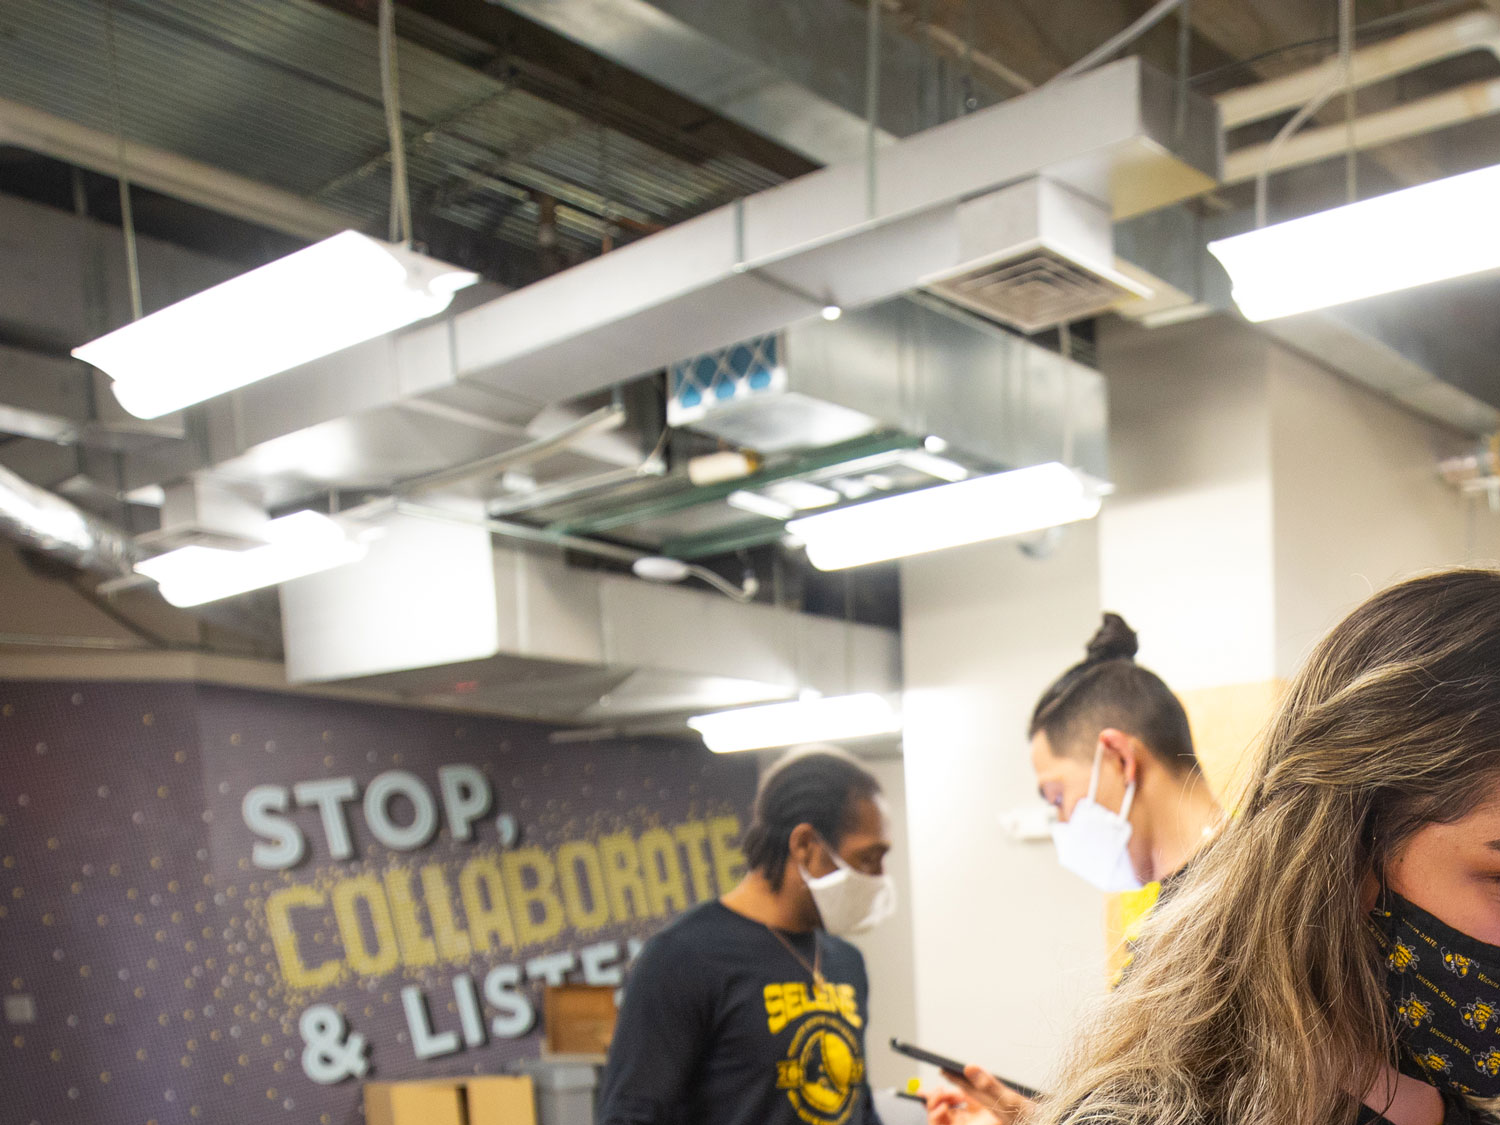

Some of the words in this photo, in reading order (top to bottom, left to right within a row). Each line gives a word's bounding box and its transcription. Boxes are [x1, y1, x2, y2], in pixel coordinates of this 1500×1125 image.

[242, 763, 519, 871] STOP,
[264, 814, 747, 990] COLLABORATE
[300, 1003, 369, 1085] &
[401, 937, 645, 1060] LISTE
